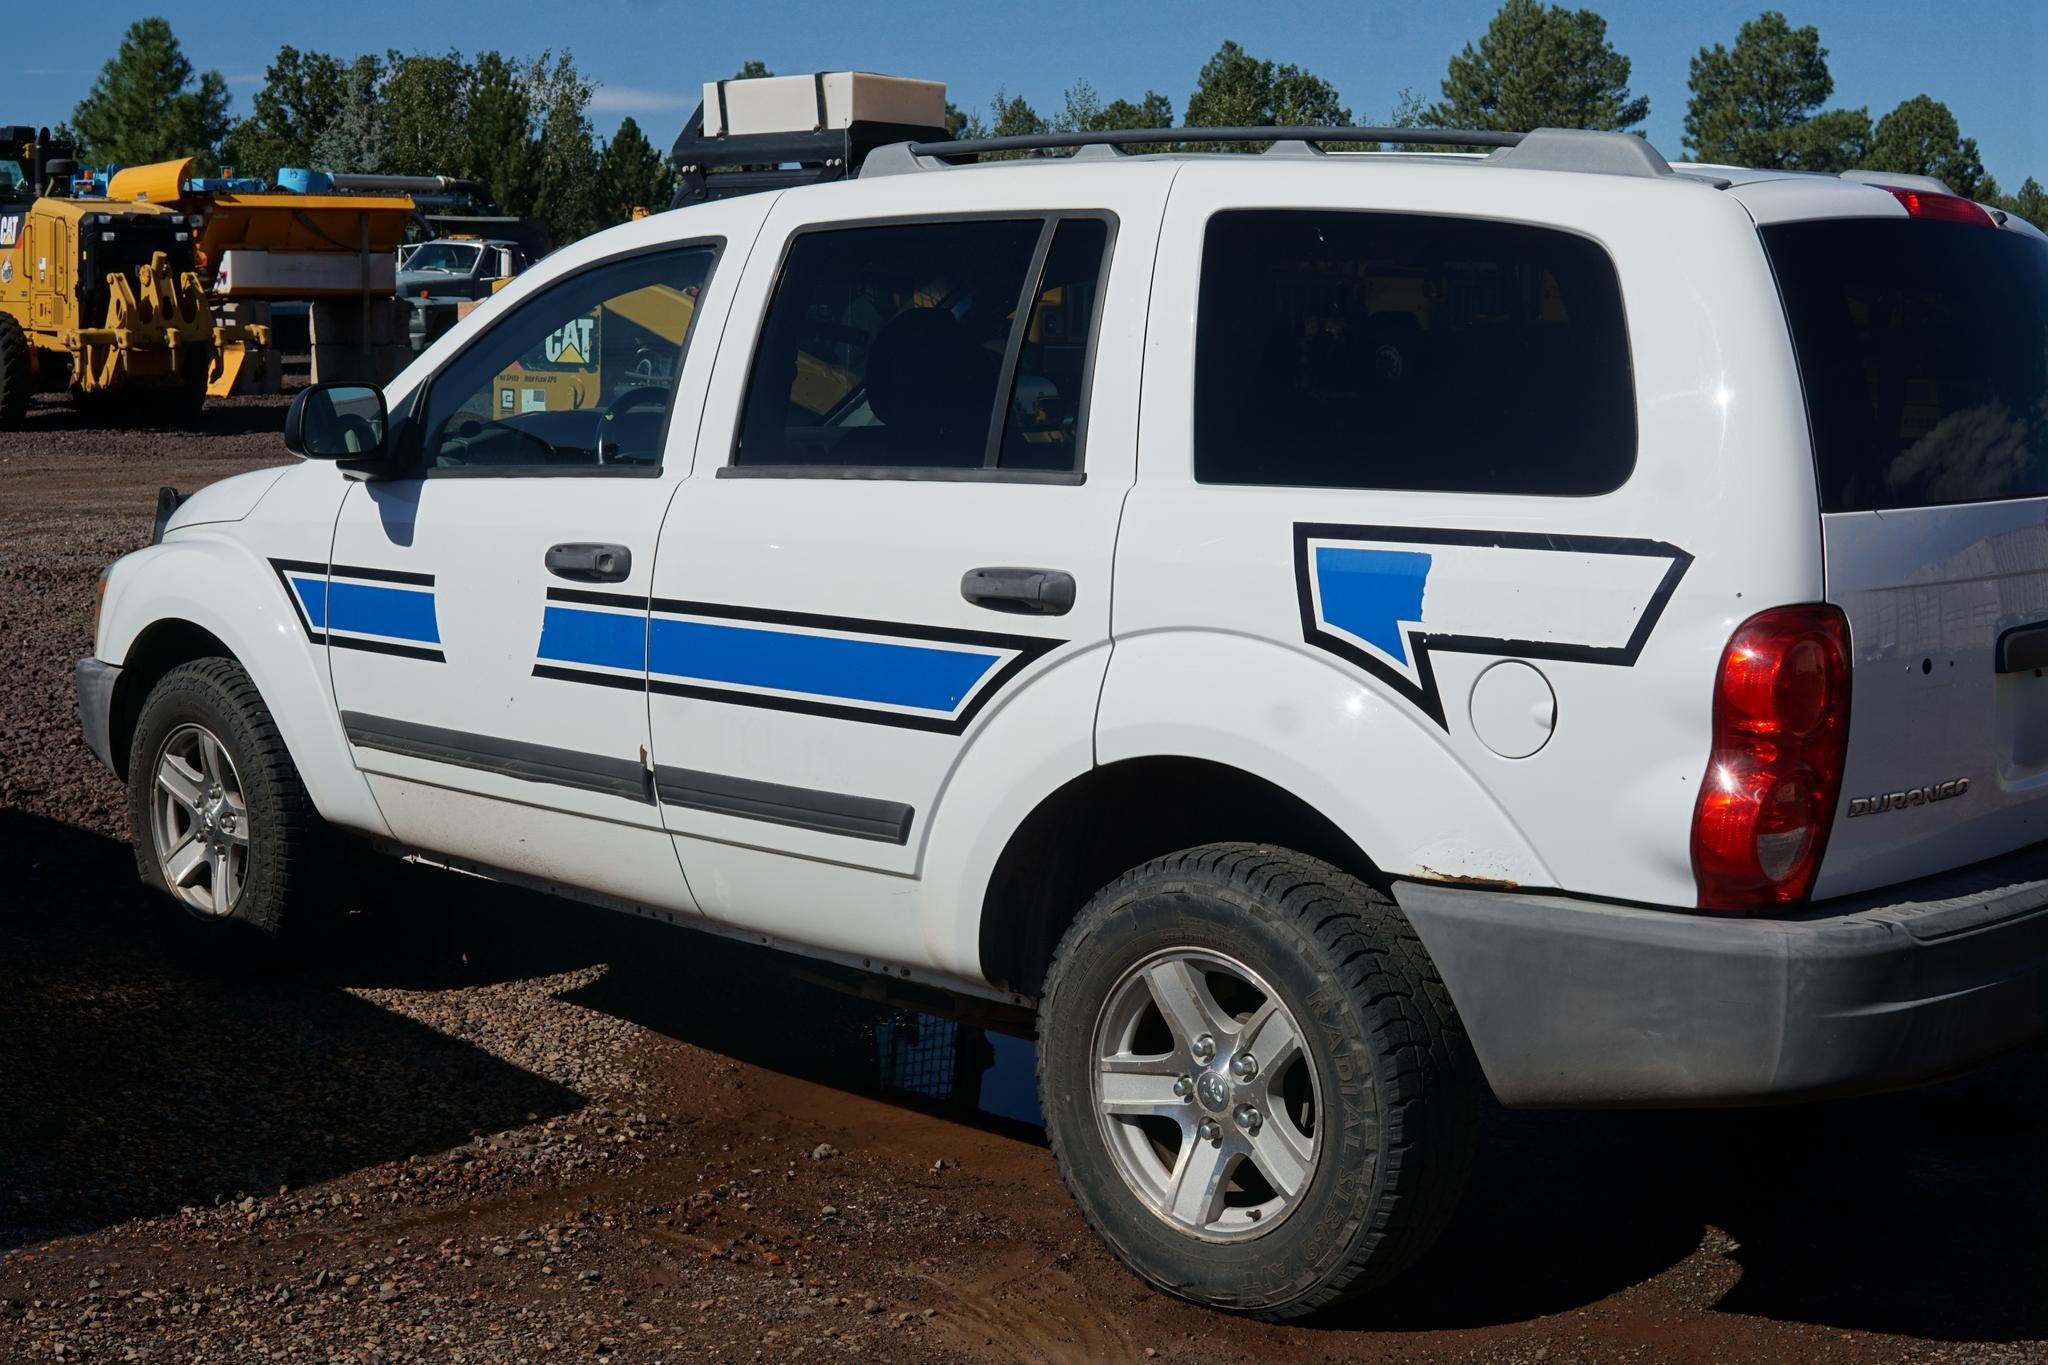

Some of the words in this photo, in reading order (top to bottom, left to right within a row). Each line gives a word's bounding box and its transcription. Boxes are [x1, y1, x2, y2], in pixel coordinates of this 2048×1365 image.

[1, 215, 19, 244] CAT
[545, 318, 594, 363] CAT
[1849, 777, 1969, 817] DURANGO
[1305, 989, 1362, 1152] RADIAL
[1302, 1167, 1355, 1261] SL369
